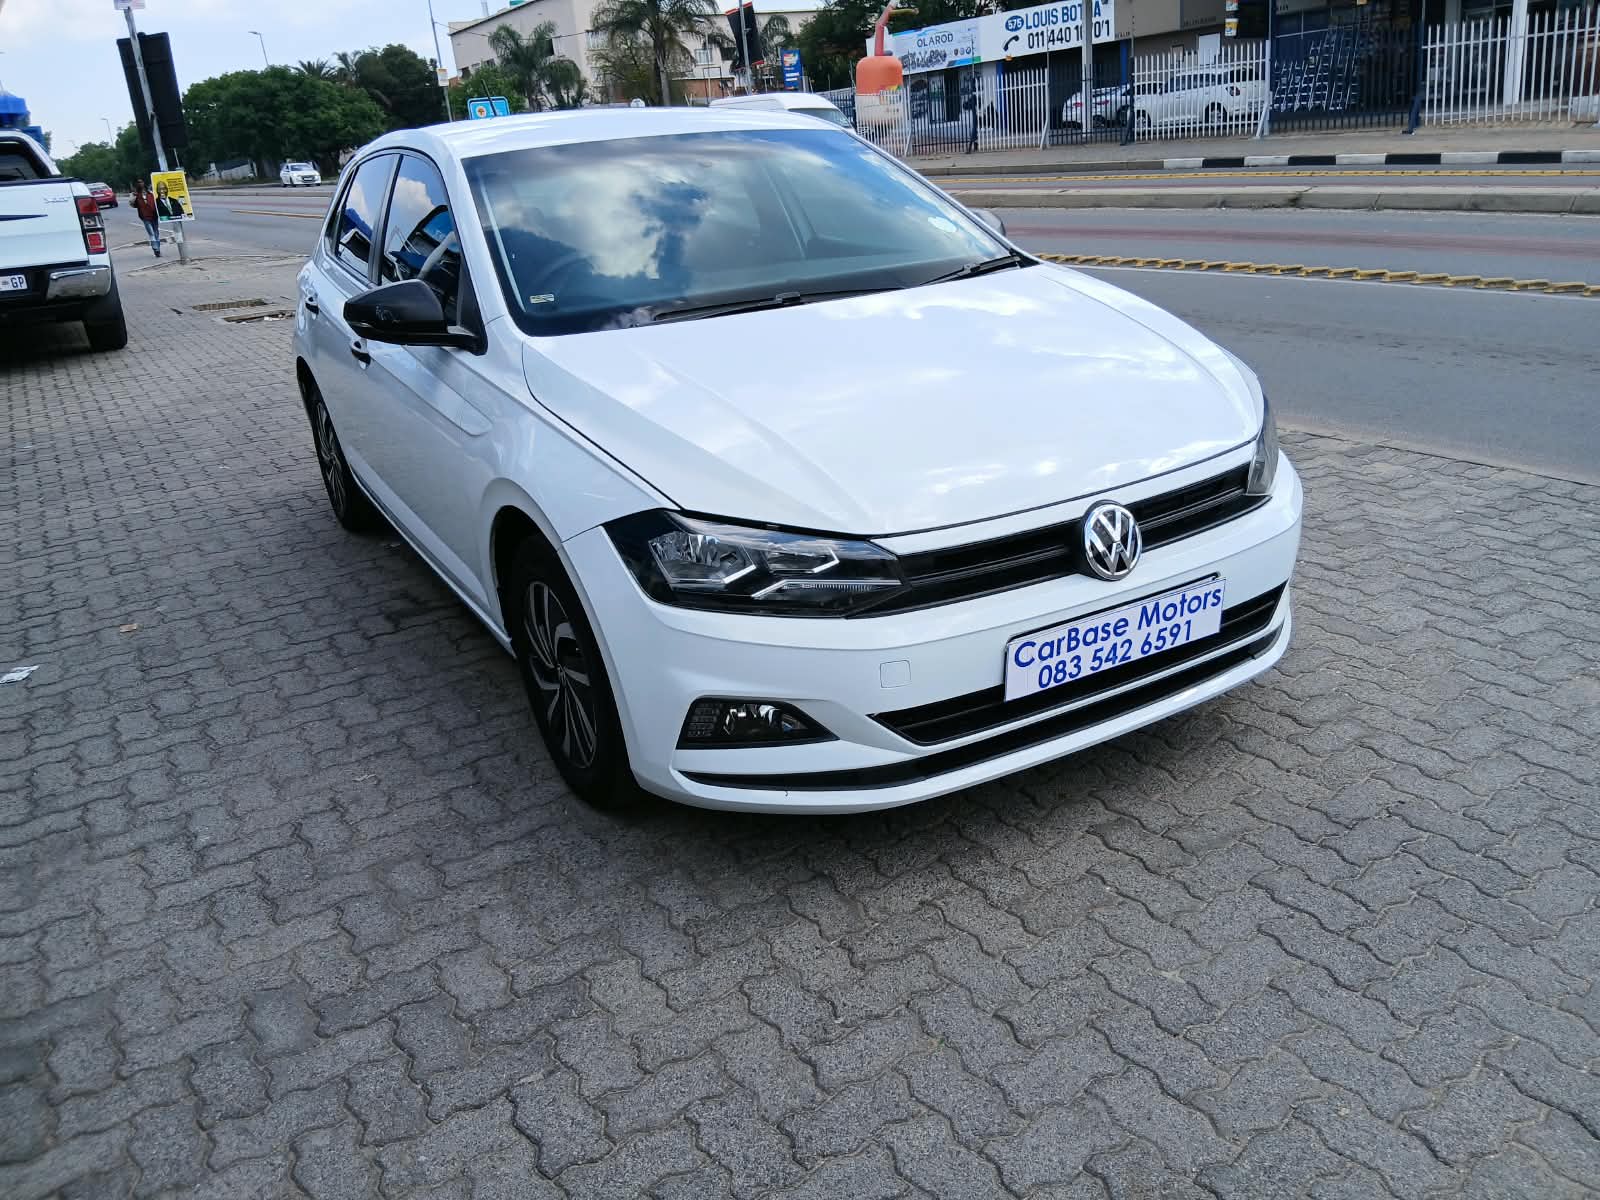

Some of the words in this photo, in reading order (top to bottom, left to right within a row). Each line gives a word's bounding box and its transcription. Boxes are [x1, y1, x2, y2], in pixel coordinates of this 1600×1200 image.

[1025, 8, 1059, 30] LOUIS
[1061, 1, 1102, 23] BOTA
[1028, 30, 1045, 49] 011
[1048, 27, 1072, 46] 440
[10, 276, 25, 289] GP
[1014, 617, 1129, 668] CarBase
[1137, 587, 1222, 630] Motors
[1038, 654, 1082, 689] 083
[1090, 639, 1133, 672] 542
[1140, 620, 1192, 655] 6591
